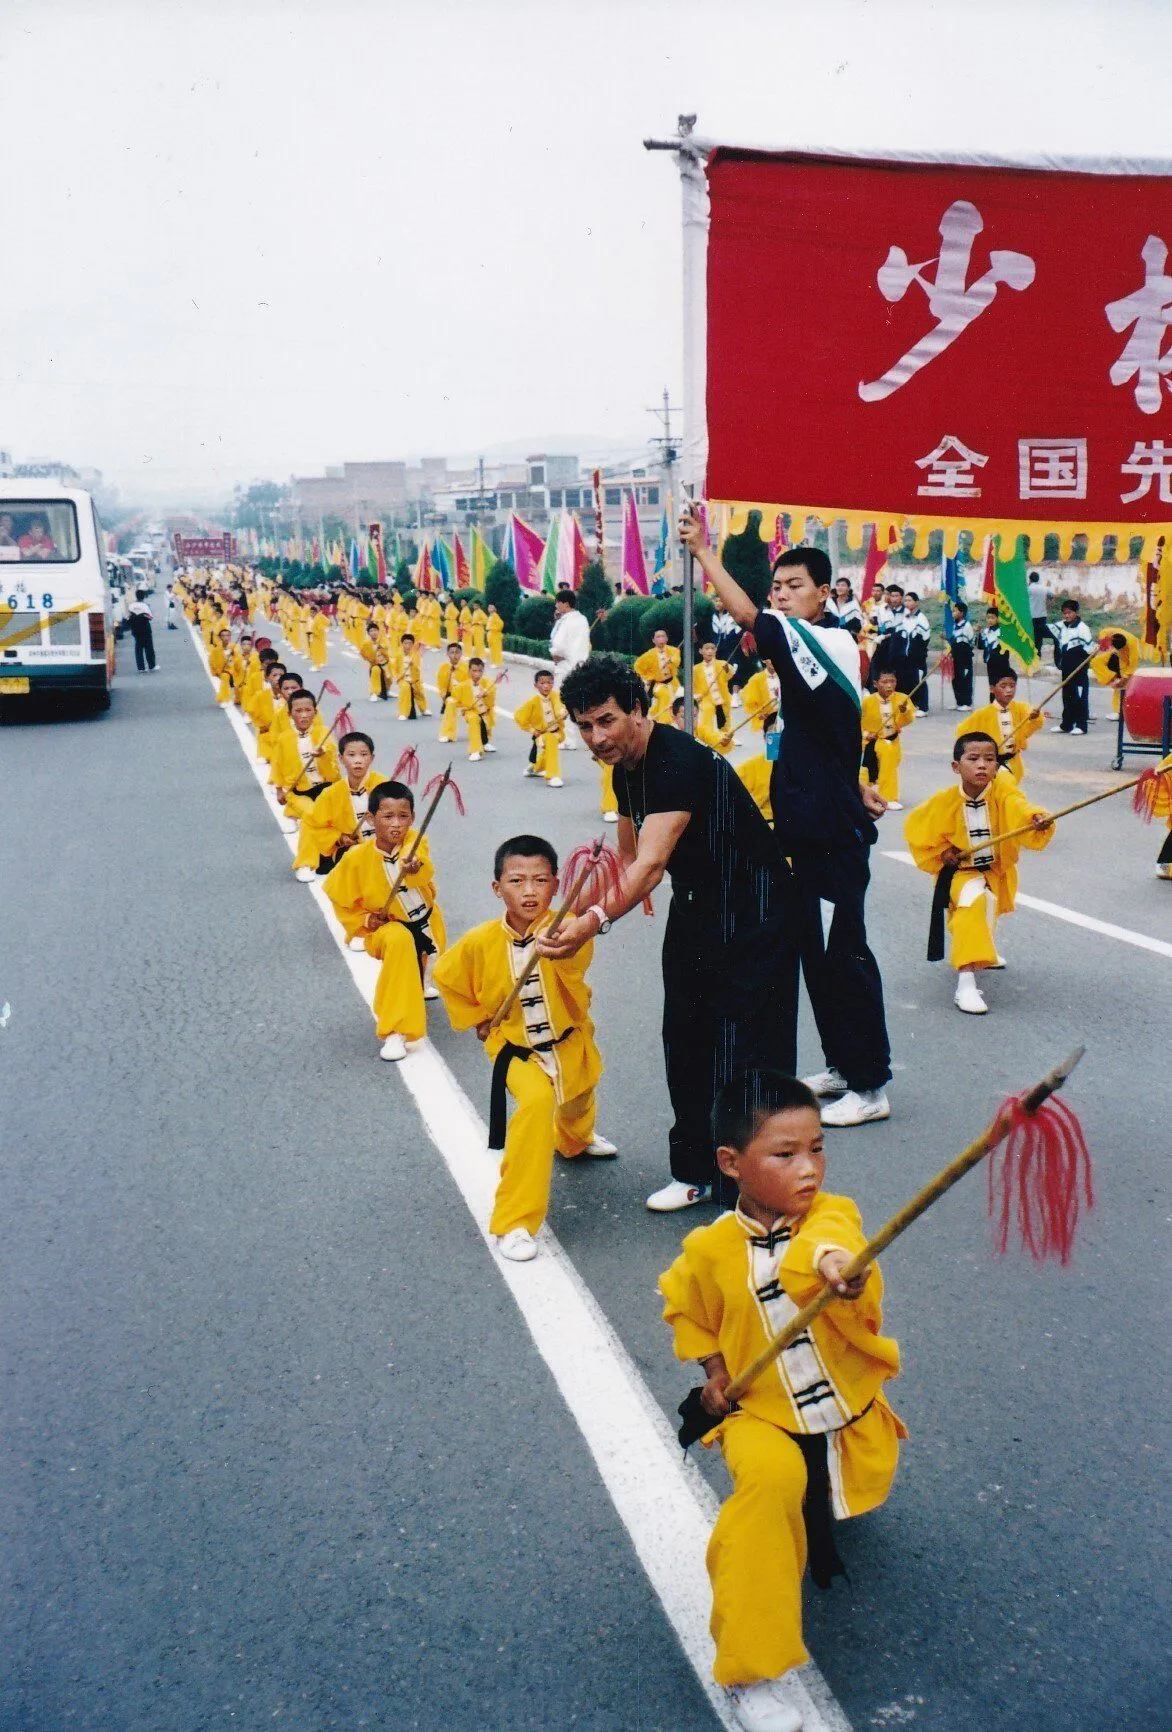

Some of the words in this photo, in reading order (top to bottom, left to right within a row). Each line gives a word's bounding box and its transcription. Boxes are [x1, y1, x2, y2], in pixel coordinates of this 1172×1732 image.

[915, 435, 1172, 504] 全国先
[7, 593, 53, 609] 618
